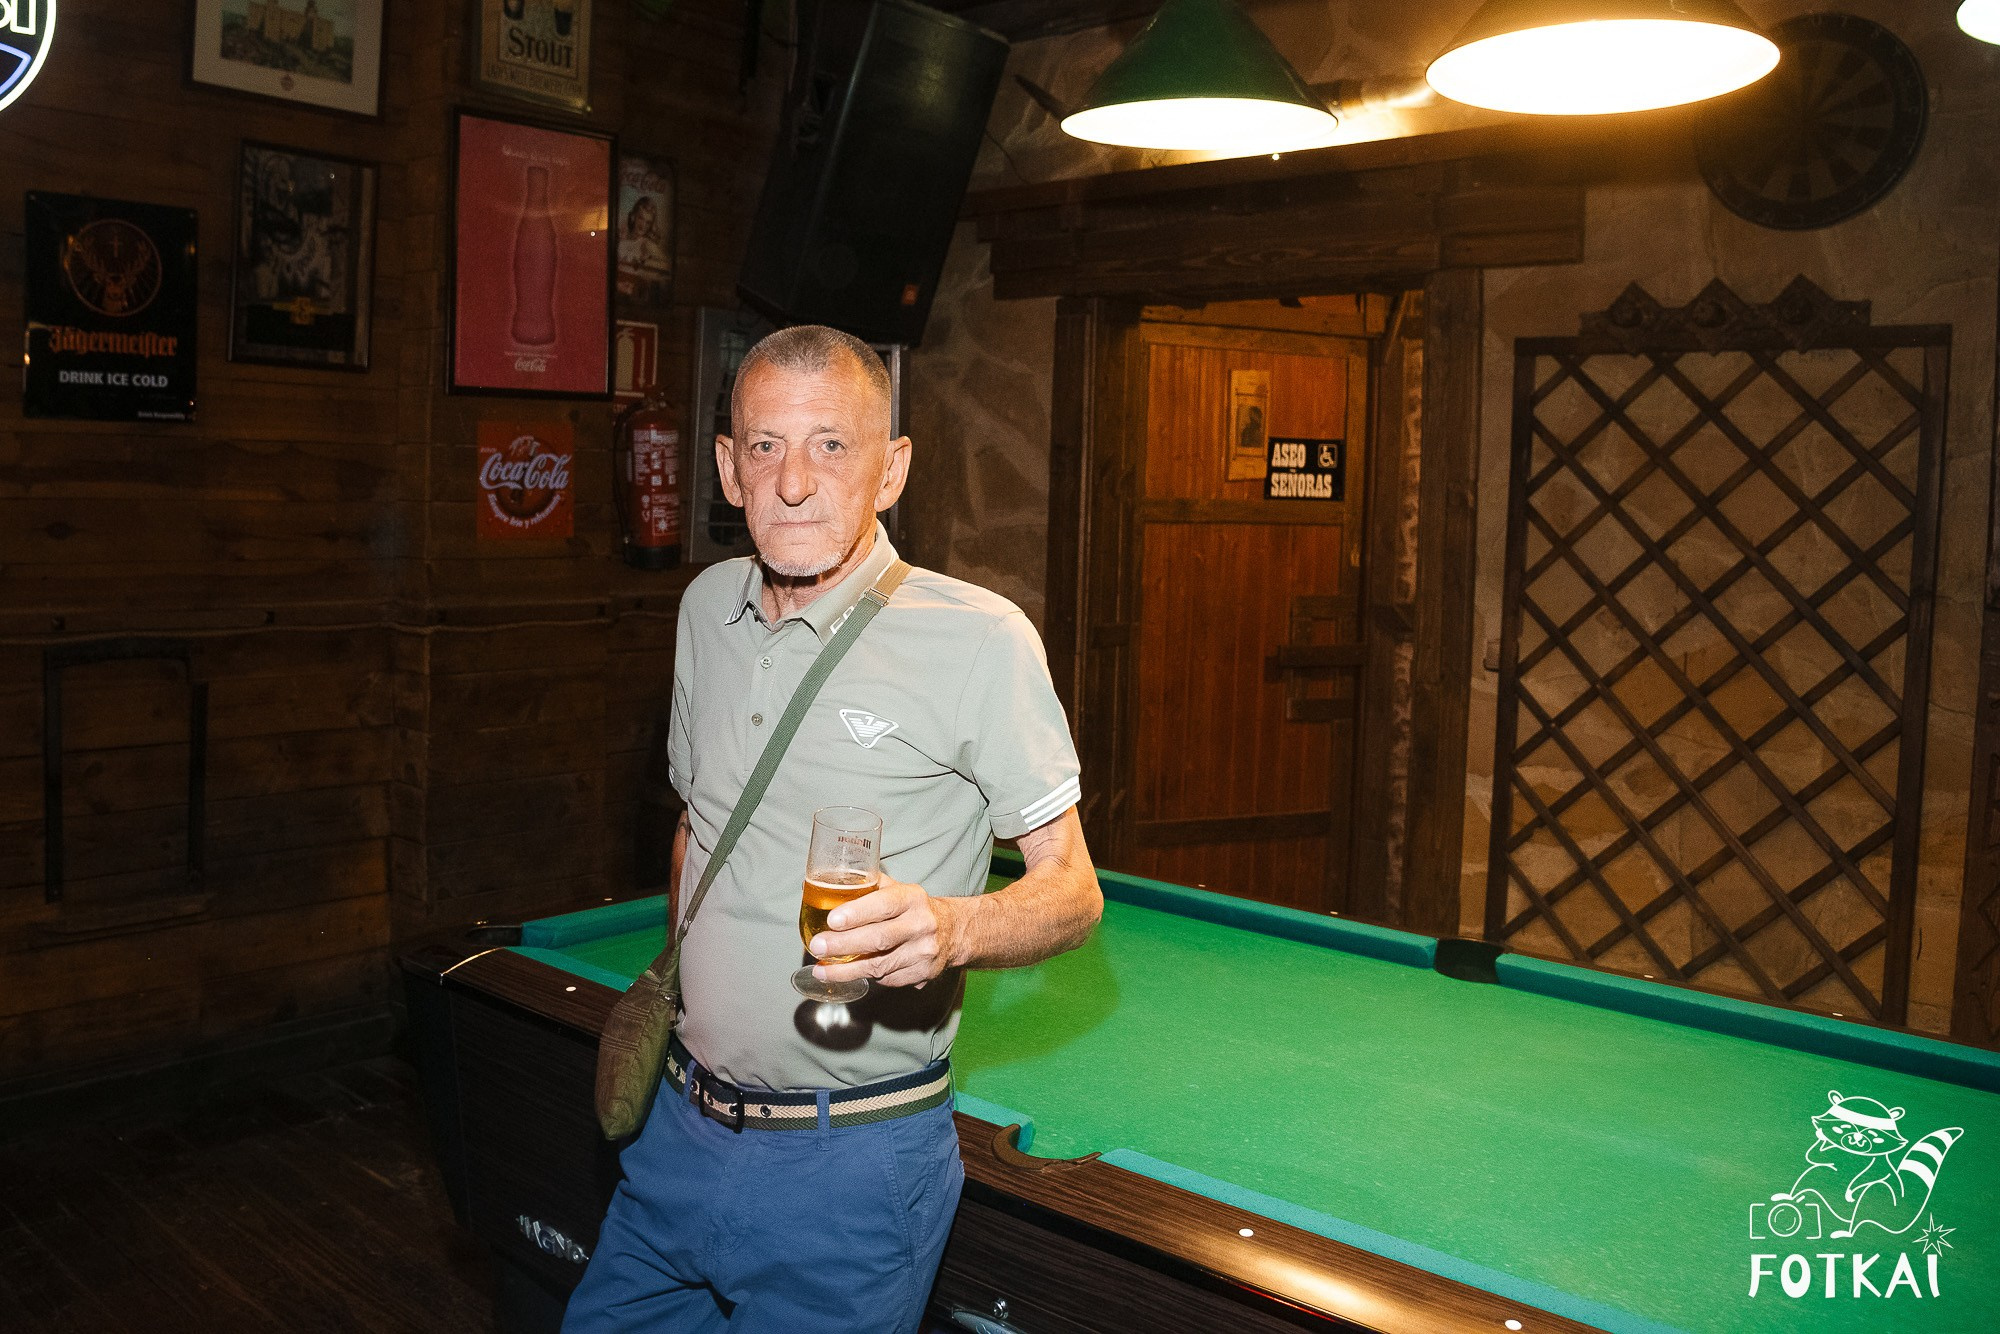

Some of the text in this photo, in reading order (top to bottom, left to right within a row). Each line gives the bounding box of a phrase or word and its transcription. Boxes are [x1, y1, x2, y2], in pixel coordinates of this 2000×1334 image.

[58, 369, 169, 388] DRINK ICE COLD
[1271, 442, 1307, 469] ASEO
[1270, 468, 1333, 499] SEÑORAS
